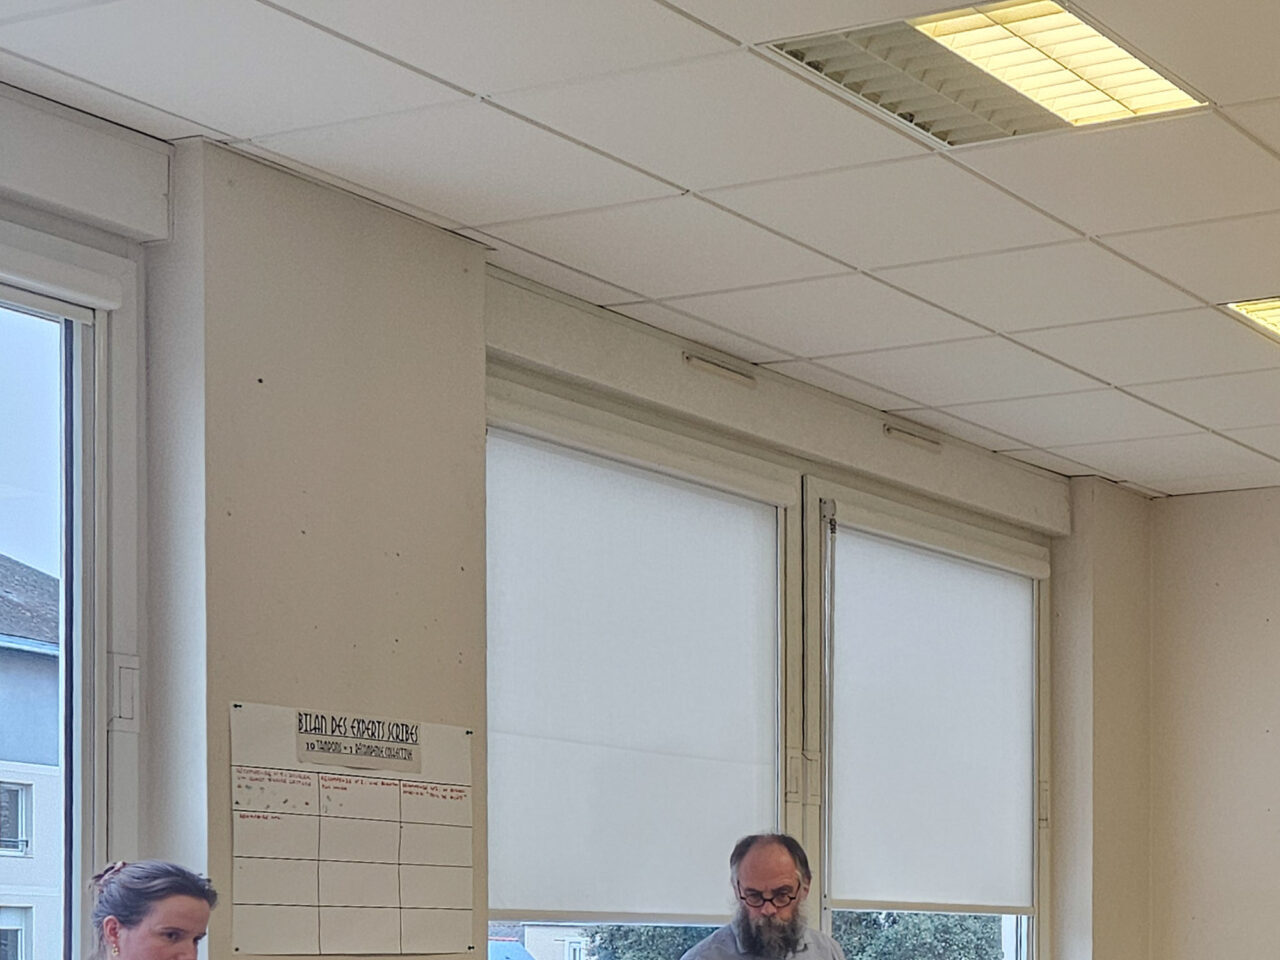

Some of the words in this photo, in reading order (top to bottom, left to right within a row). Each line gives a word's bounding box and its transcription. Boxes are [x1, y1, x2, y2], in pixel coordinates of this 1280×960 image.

[298, 712, 327, 734] BILAN
[331, 715, 347, 736] DES
[350, 718, 385, 740] EXPERTS
[387, 721, 418, 743] SCRIBES
[306, 742, 315, 750] 10
